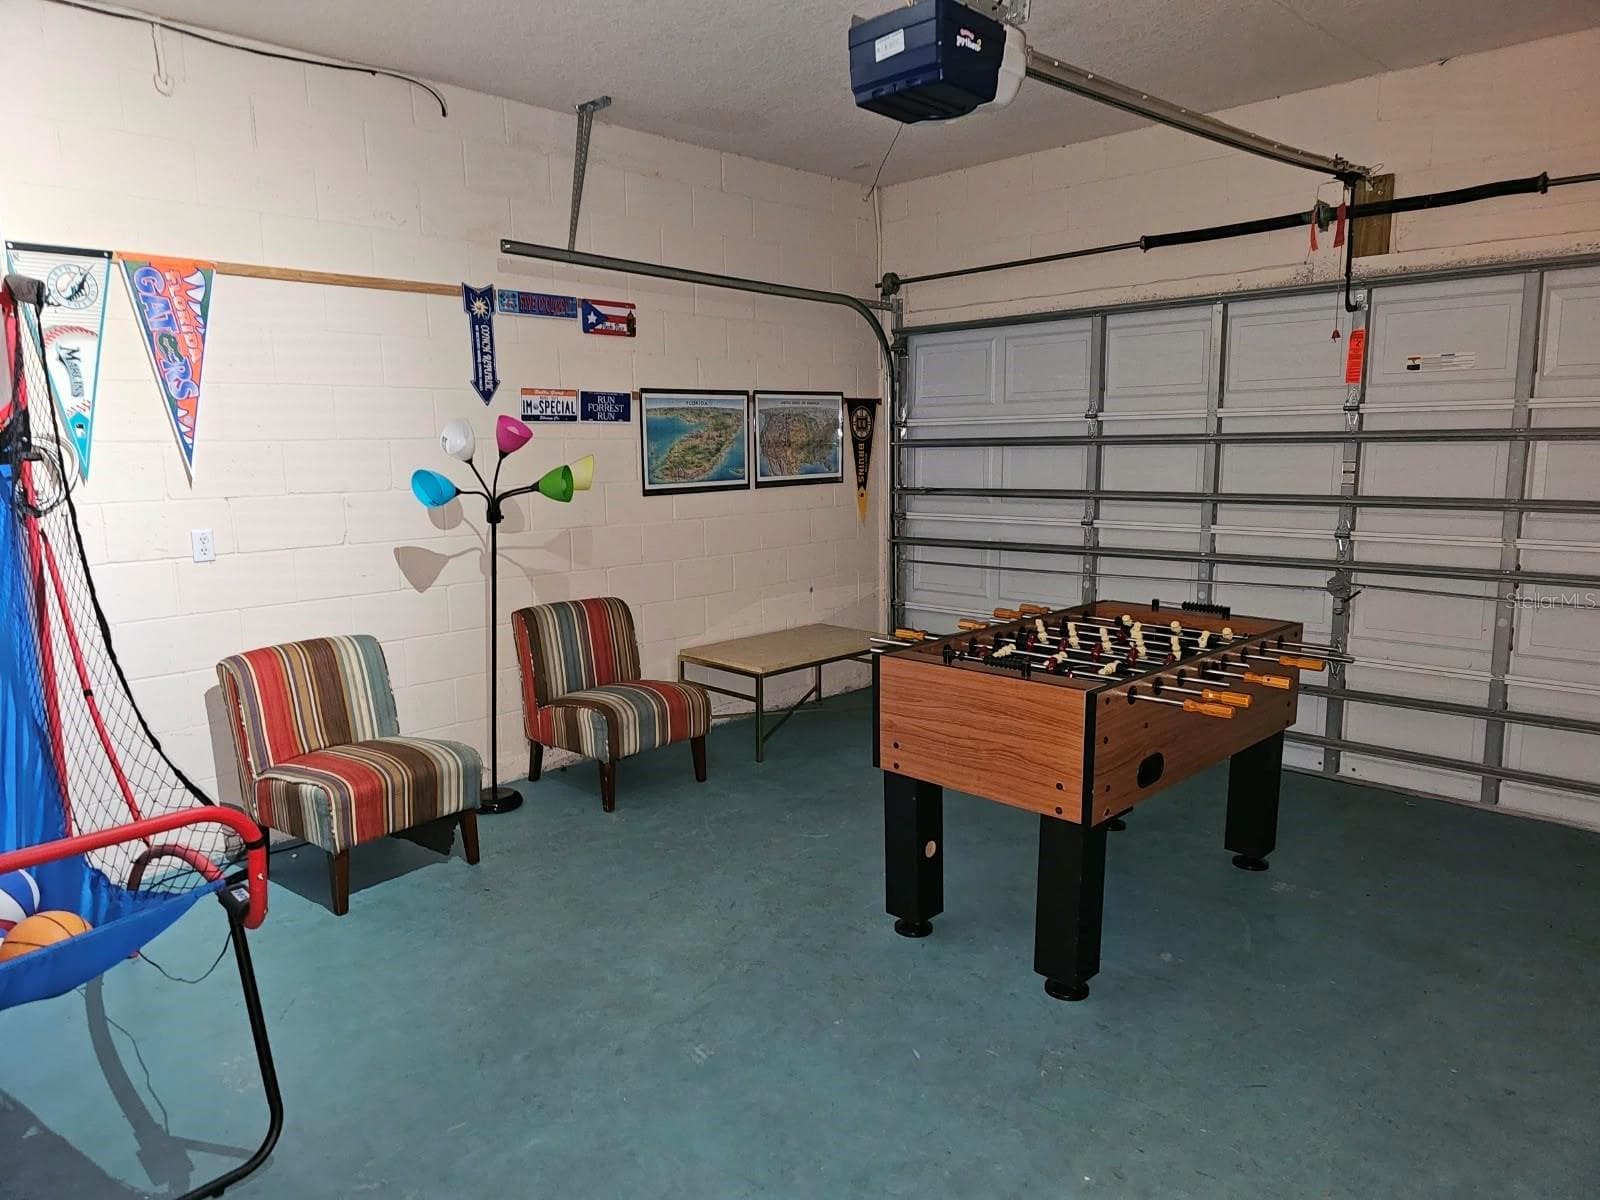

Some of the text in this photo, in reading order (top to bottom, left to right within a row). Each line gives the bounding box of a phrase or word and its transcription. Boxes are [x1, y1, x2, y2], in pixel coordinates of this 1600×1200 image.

[164, 269, 204, 364] FLORIDA
[597, 395, 616, 404] RUN
[522, 399, 576, 415] IM SPECIAL
[587, 403, 625, 413] FORREST
[597, 412, 616, 421] RUN
